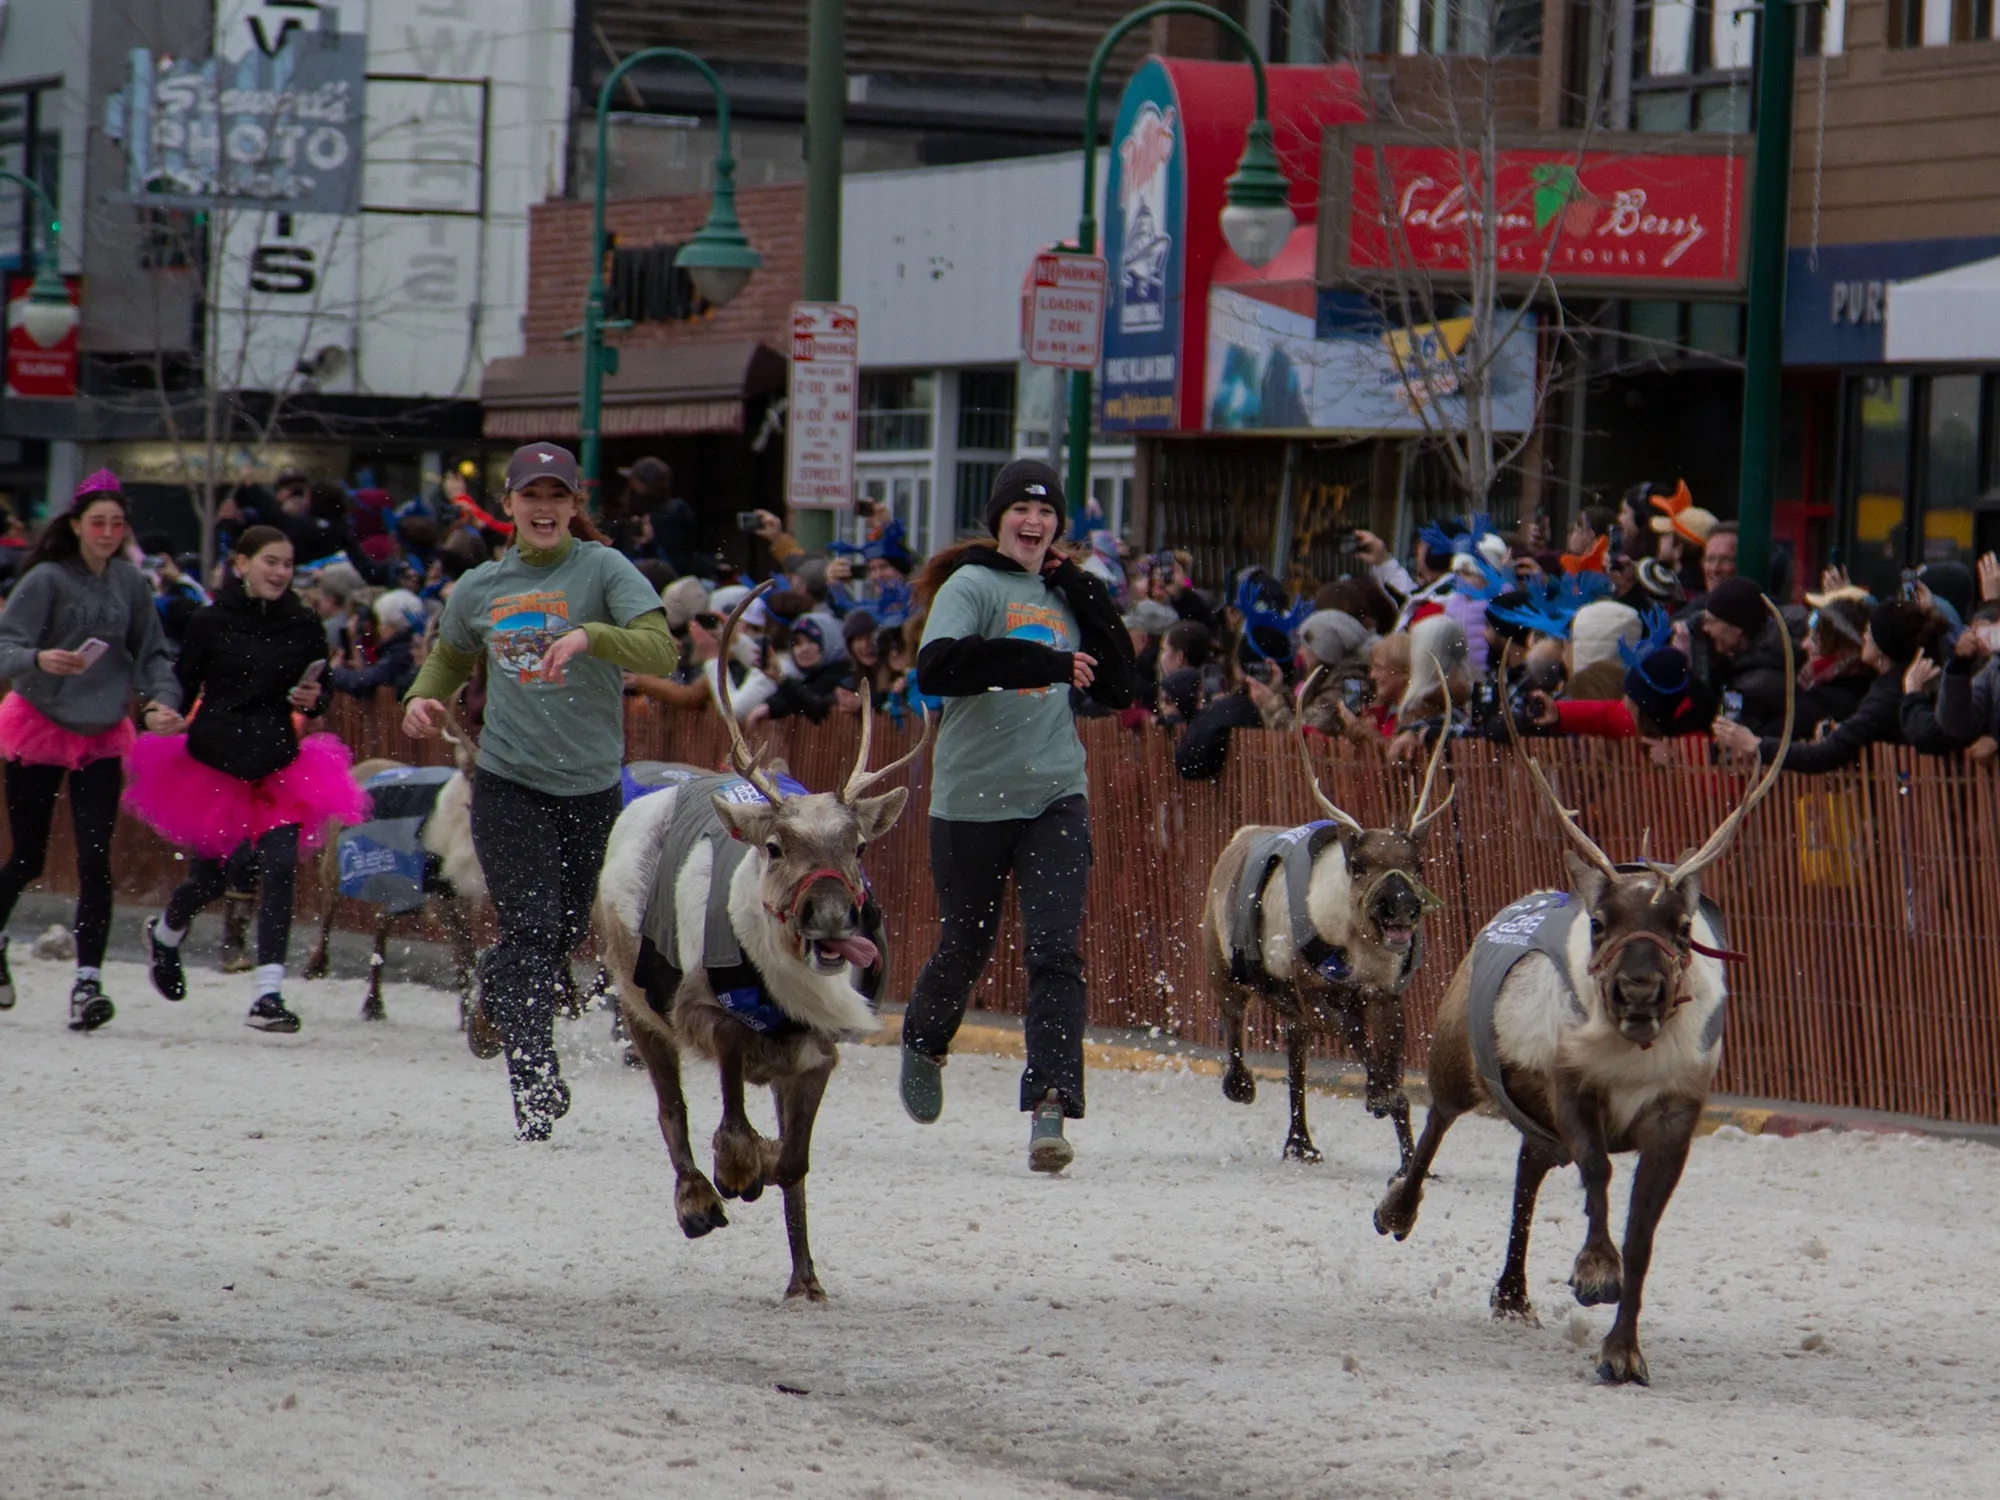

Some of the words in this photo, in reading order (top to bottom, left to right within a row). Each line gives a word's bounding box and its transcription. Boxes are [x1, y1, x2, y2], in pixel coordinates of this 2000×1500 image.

[152, 117, 350, 171] PHOTO
[1597, 187, 1706, 268] Berry
[1433, 243, 1527, 263] TREL
[1566, 247, 1648, 265] TOURS
[1036, 260, 1057, 283] NO
[1058, 264, 1104, 285] PARKING
[1041, 296, 1095, 315] LOADING
[1831, 280, 1890, 325] PUR
[1048, 318, 1083, 334] ZONE
[800, 467, 842, 480] STREET
[794, 483, 850, 498] CLEANING
